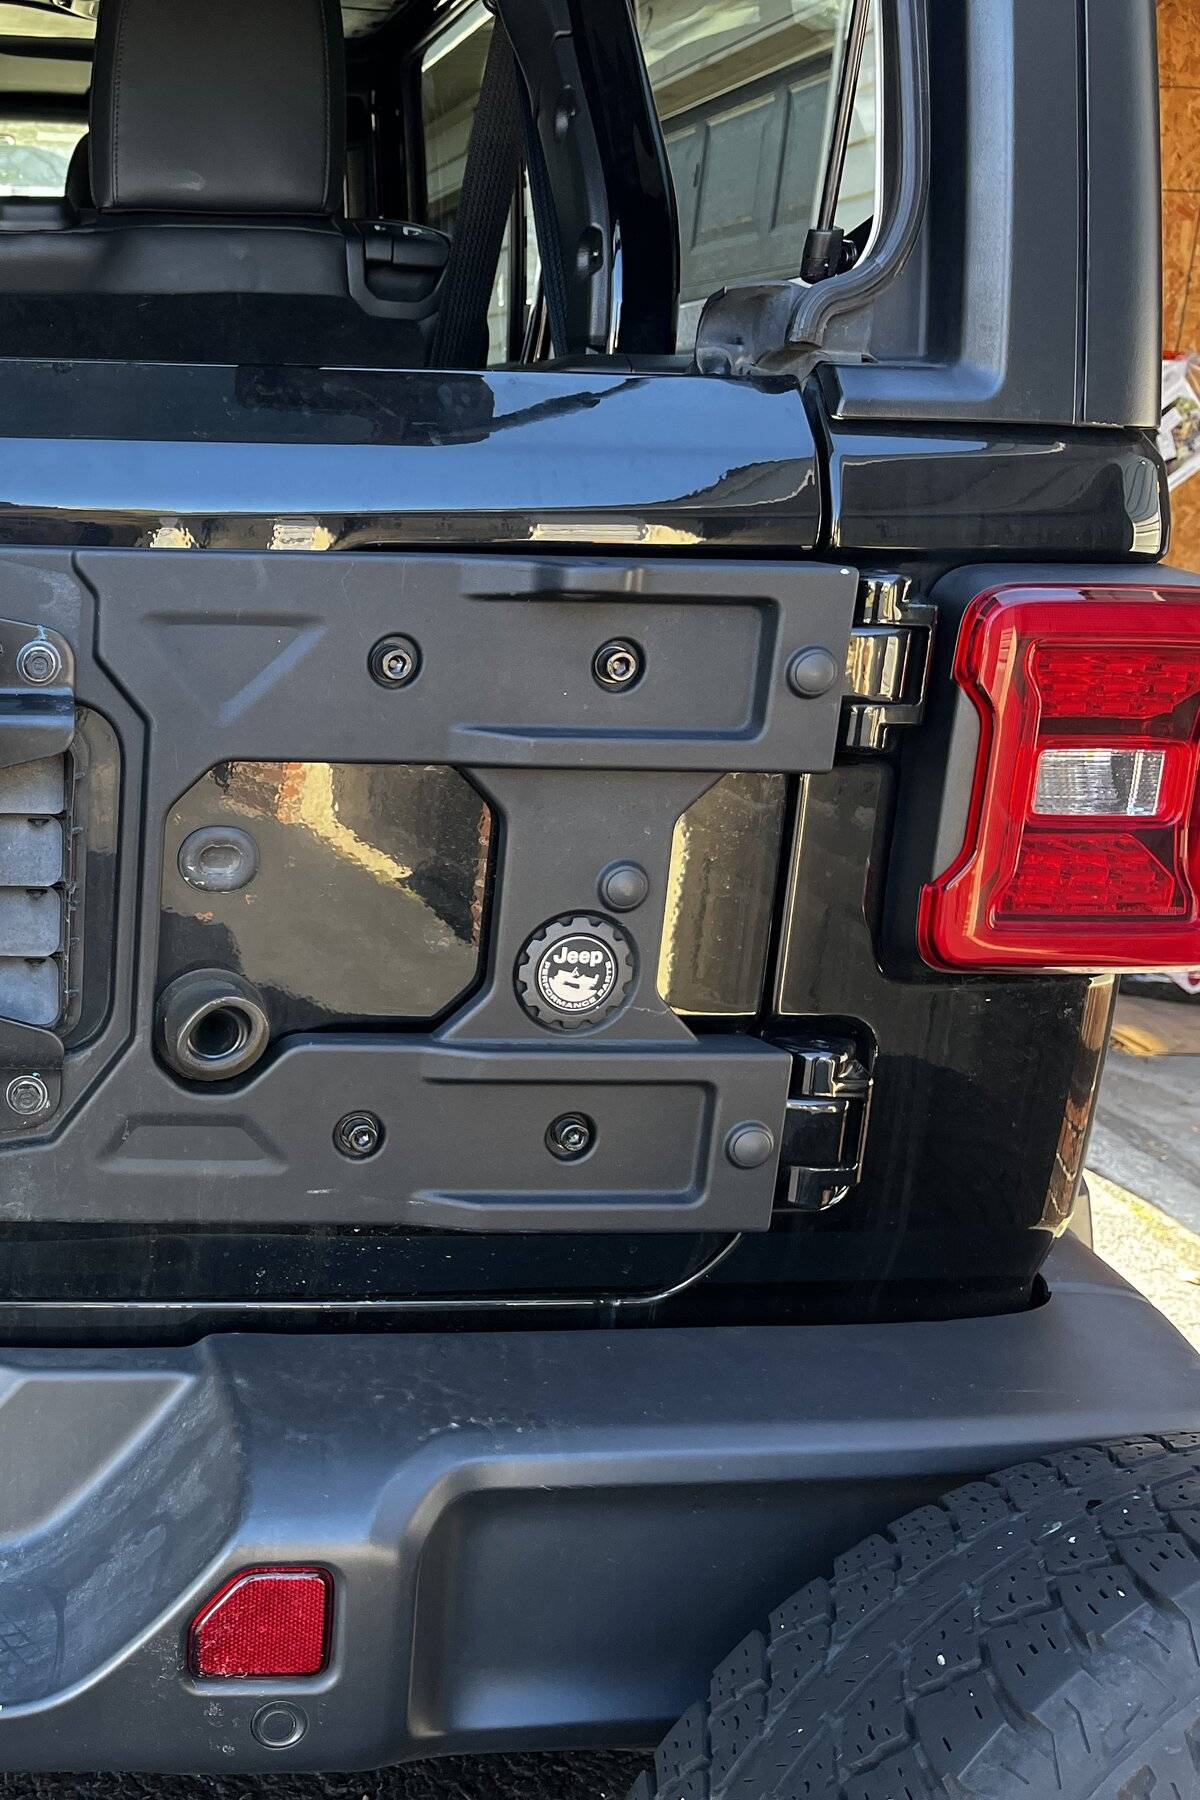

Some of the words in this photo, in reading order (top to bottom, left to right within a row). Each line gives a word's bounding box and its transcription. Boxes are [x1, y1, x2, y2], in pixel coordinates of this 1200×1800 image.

[553, 947, 603, 967] Jeep
[542, 961, 596, 1008] PERFORMANCE
[598, 961, 612, 997] PARTS
